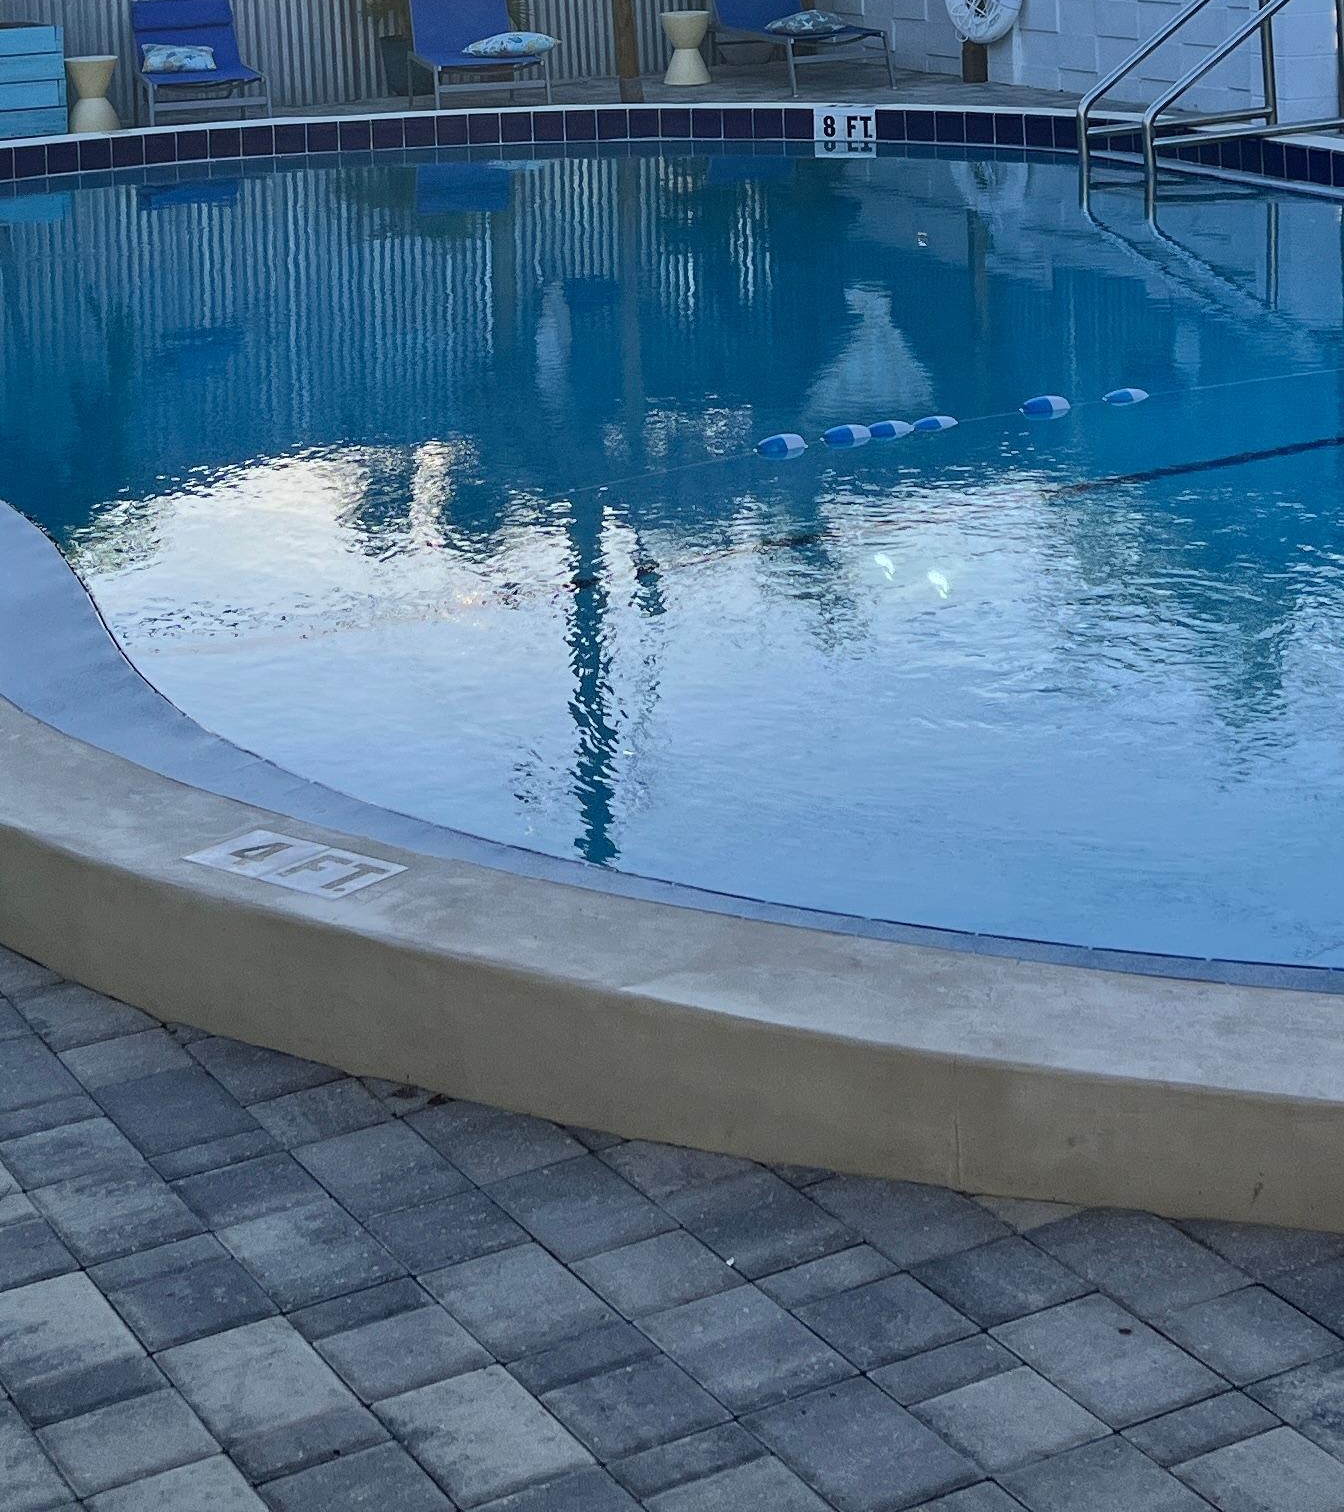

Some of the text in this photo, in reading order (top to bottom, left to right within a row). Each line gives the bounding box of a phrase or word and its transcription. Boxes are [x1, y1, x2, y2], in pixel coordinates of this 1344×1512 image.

[823, 115, 873, 139] 8 FT.
[276, 854, 390, 893] FT.
